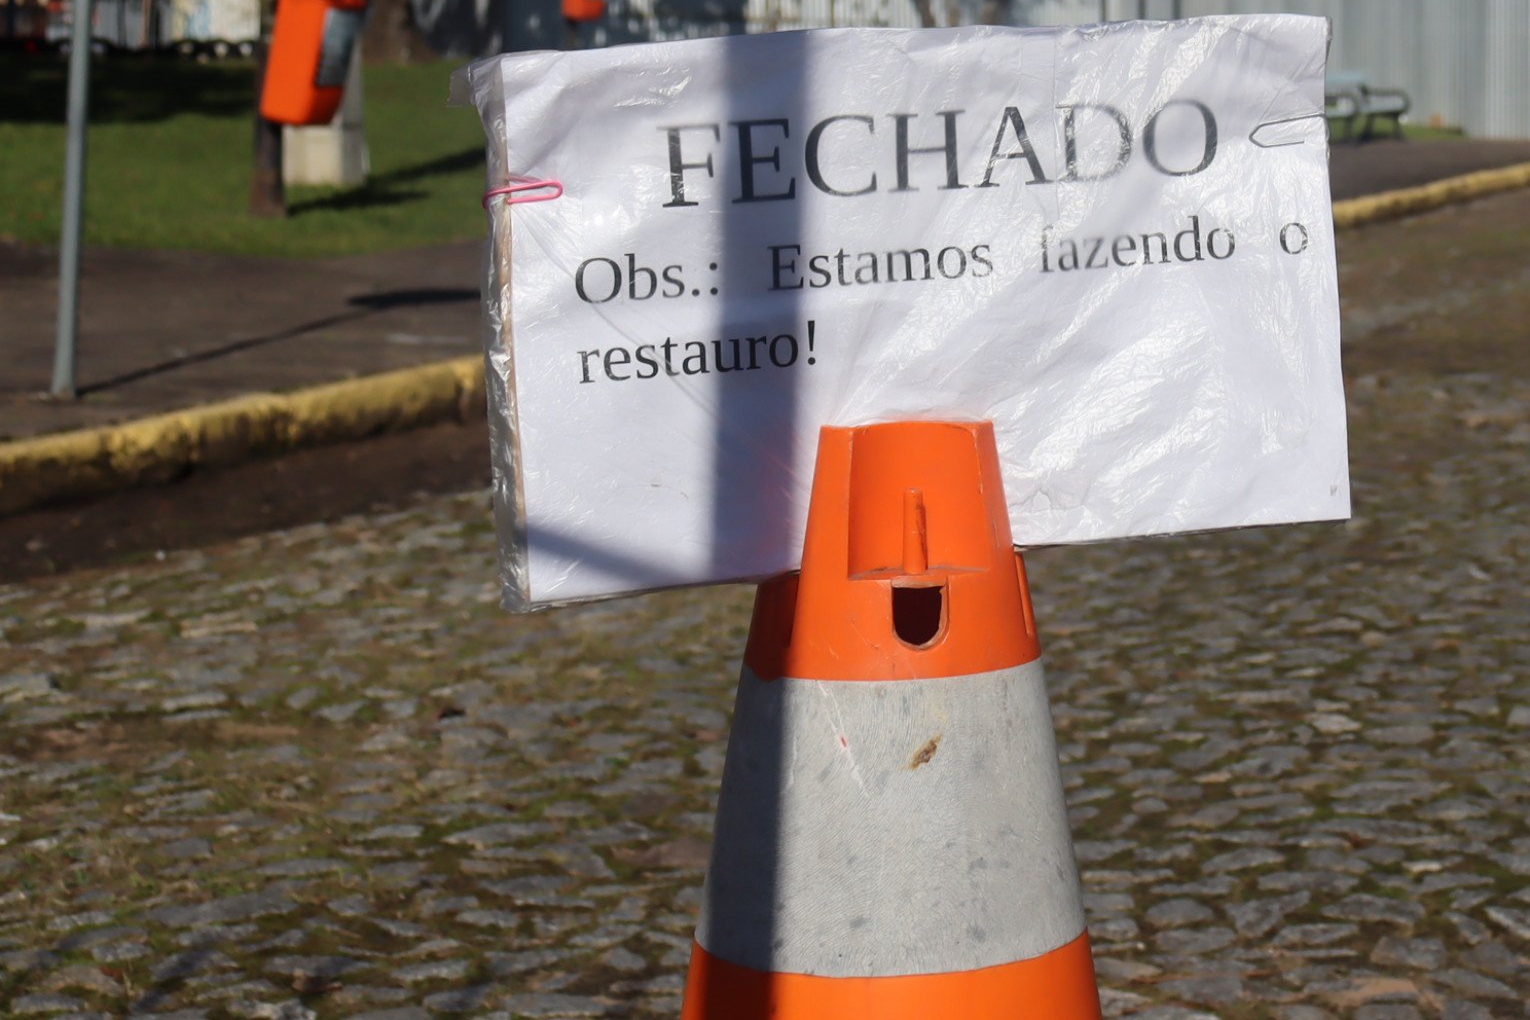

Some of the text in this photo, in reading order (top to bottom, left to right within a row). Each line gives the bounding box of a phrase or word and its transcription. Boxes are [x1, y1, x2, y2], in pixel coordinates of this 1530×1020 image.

[658, 98, 1219, 209] FECHADO
[574, 214, 1309, 305] Obs.: Estamos fazendo o
[577, 320, 817, 385] restauro!
